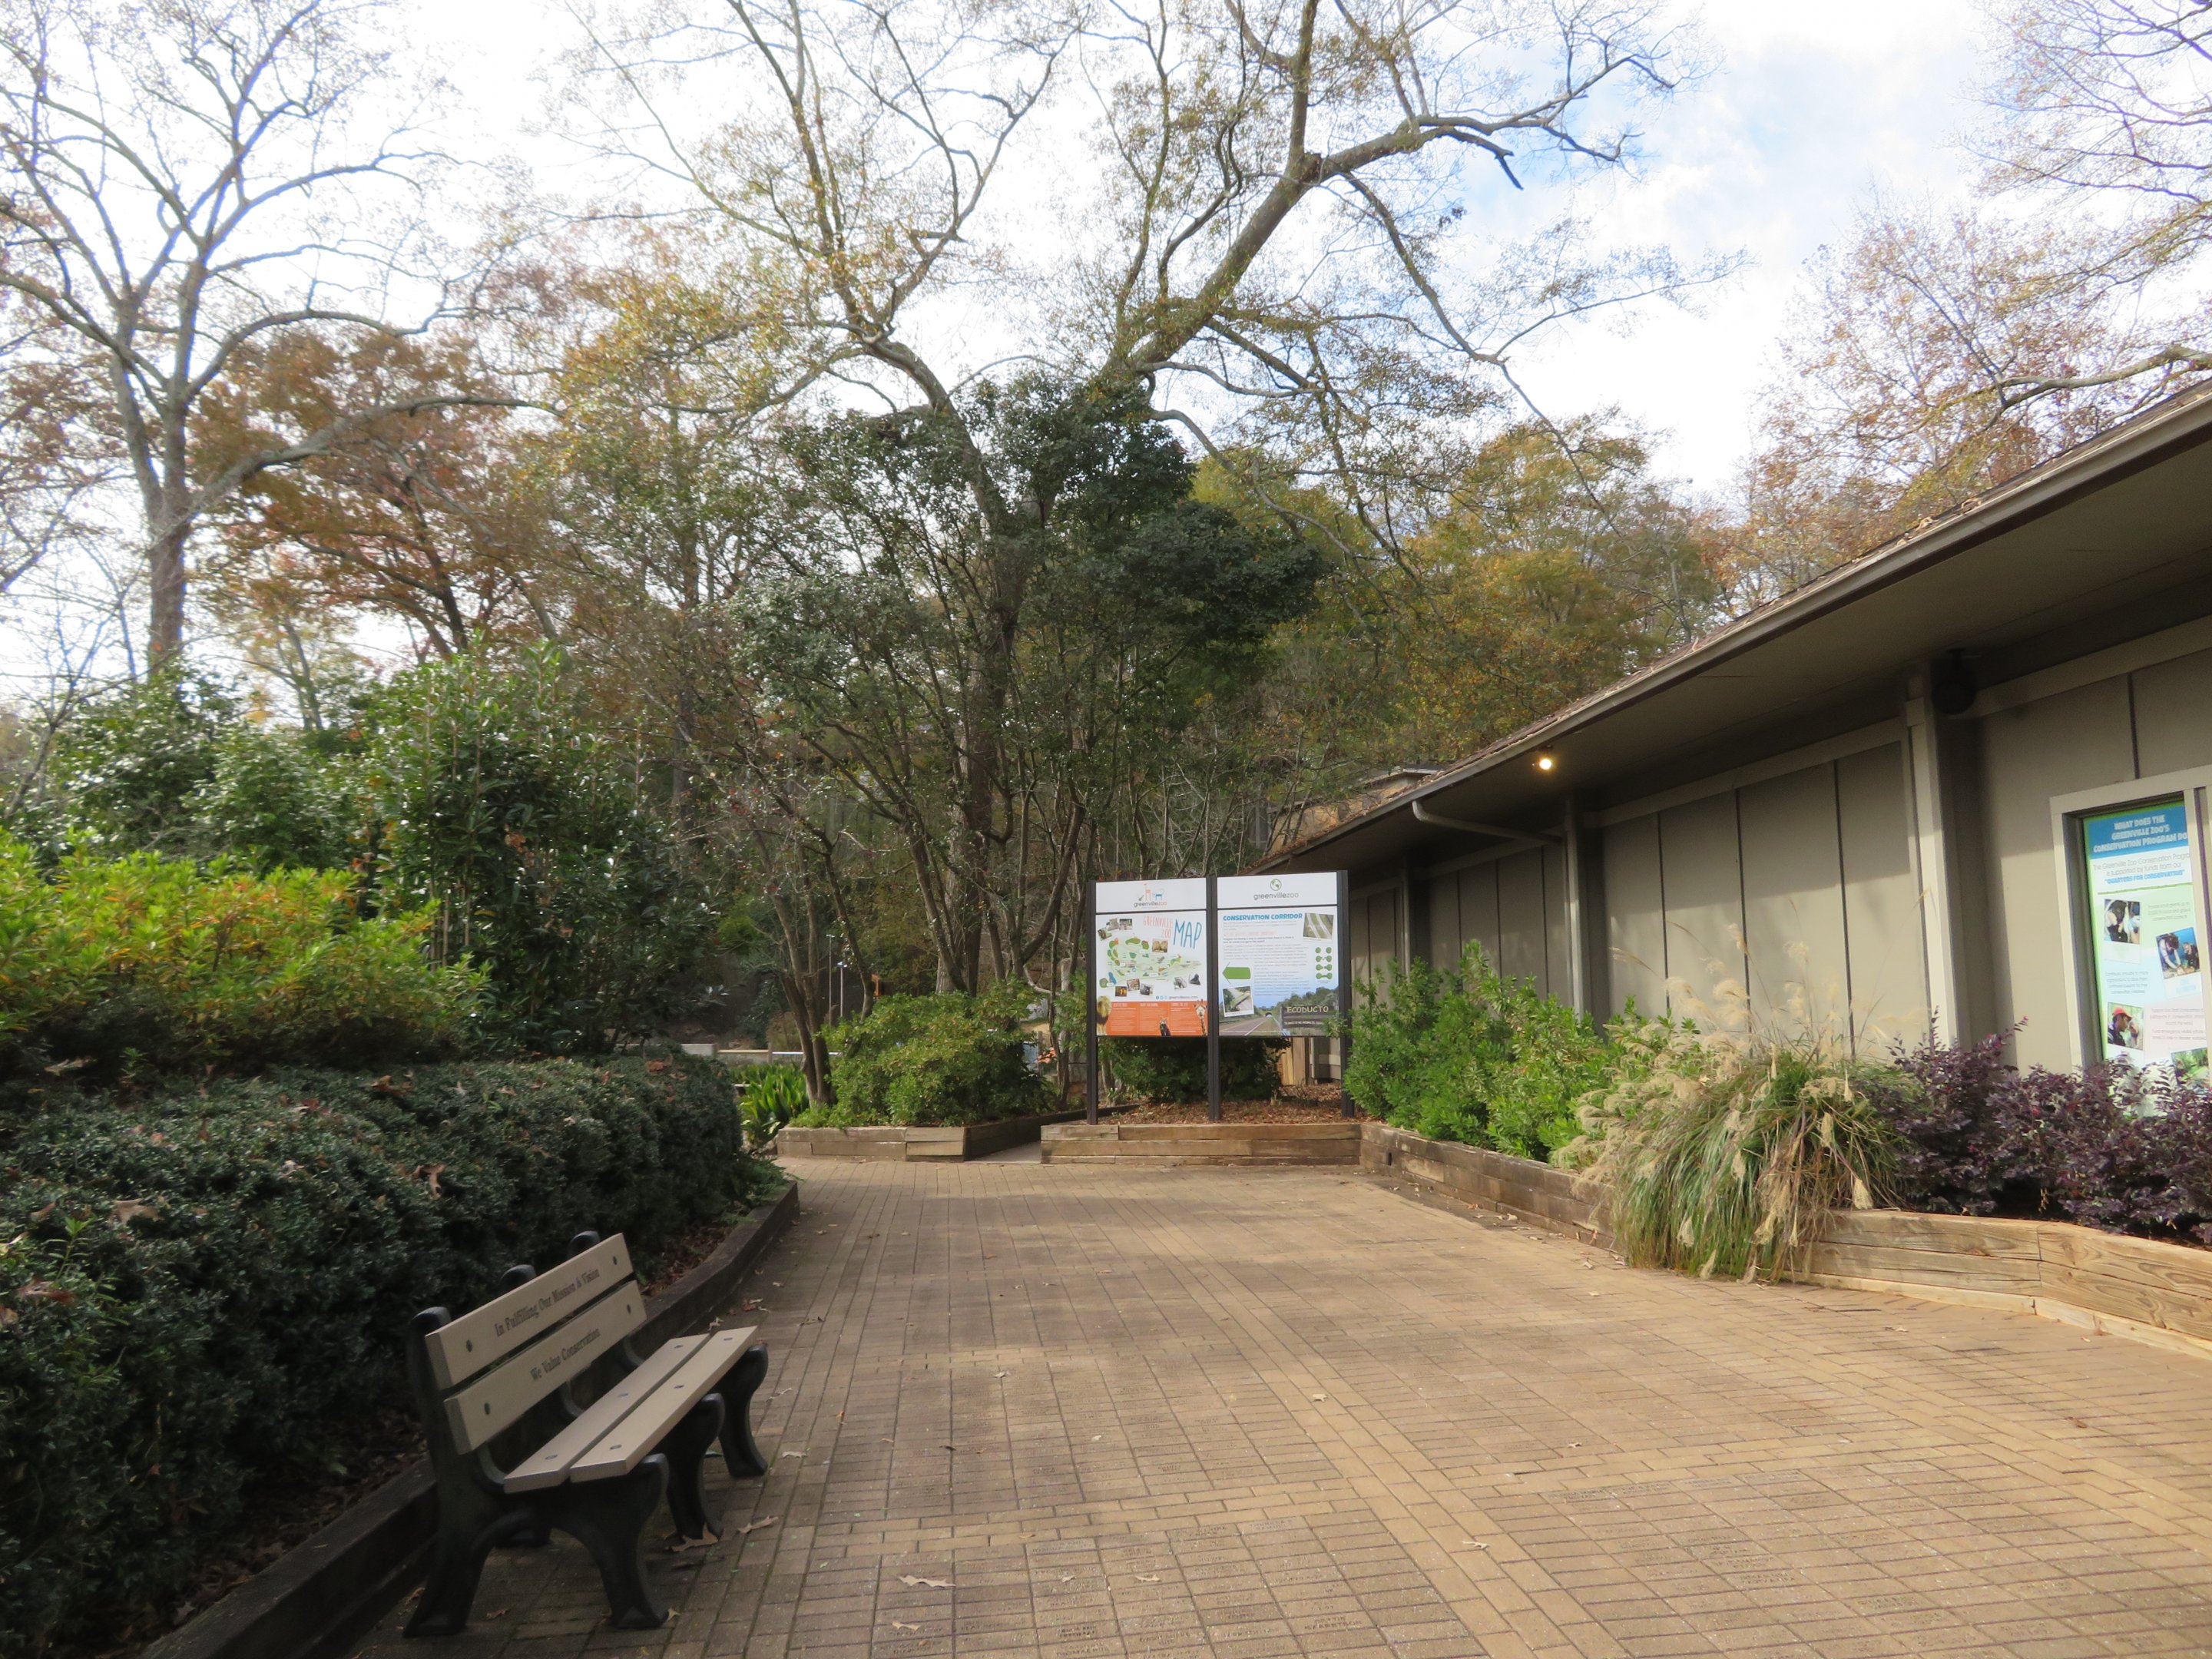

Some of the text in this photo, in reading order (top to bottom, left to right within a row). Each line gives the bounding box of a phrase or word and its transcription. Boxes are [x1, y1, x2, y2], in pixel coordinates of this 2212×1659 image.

[2114, 815, 2165, 830] WHAT DOES THE
[2111, 829, 2149, 840] GREENVILLE
[2093, 839, 2141, 853] CONSERVATION
[2142, 833, 2177, 846] PROGRAM
[2138, 856, 2172, 865] Conservation
[1253, 892, 1300, 901] greenvillezoo
[1143, 916, 1202, 949] GREENVILLE MAP
[1161, 929, 1172, 939] ZOO
[495, 1322, 505, 1337] In
[504, 1304, 540, 1331] Fulfilling
[538, 1296, 552, 1311] Our
[551, 1282, 576, 1303] Mission
[581, 1269, 601, 1284] Vision
[530, 1328, 601, 1382] We Value Conservation
